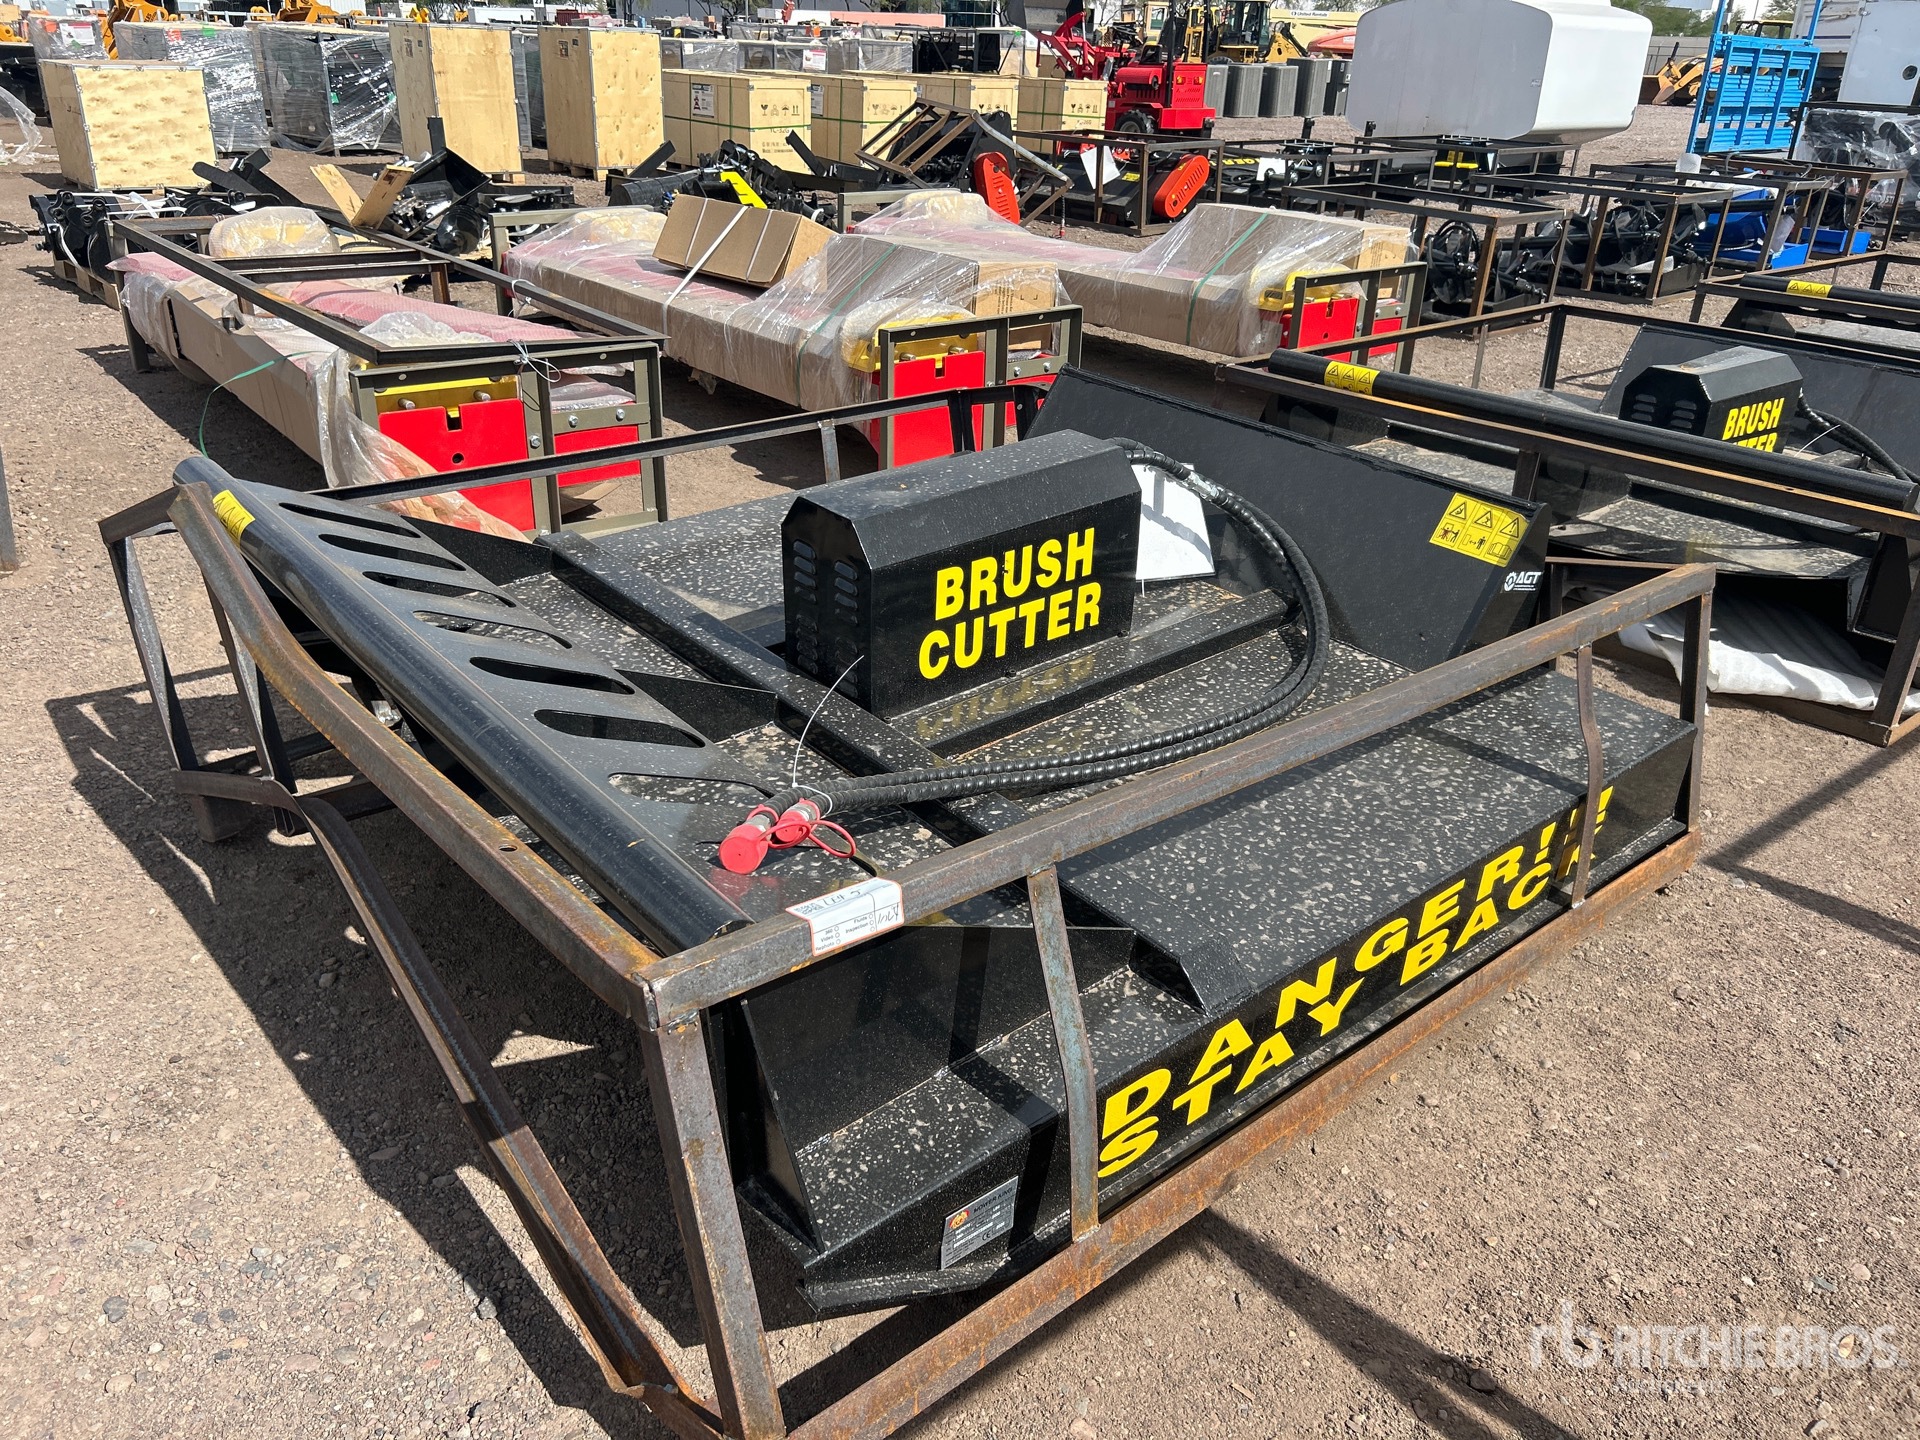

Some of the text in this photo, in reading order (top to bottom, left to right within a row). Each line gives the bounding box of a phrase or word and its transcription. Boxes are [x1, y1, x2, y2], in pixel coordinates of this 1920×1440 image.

[1722, 397, 1785, 440] BRUSH
[935, 527, 1095, 621] BRUSH
[1515, 571, 1542, 584] AGT
[918, 581, 1102, 680] CUTTER
[821, 935, 834, 943] Video
[845, 922, 869, 934] Inspection
[1097, 976, 1365, 1178] STAY
